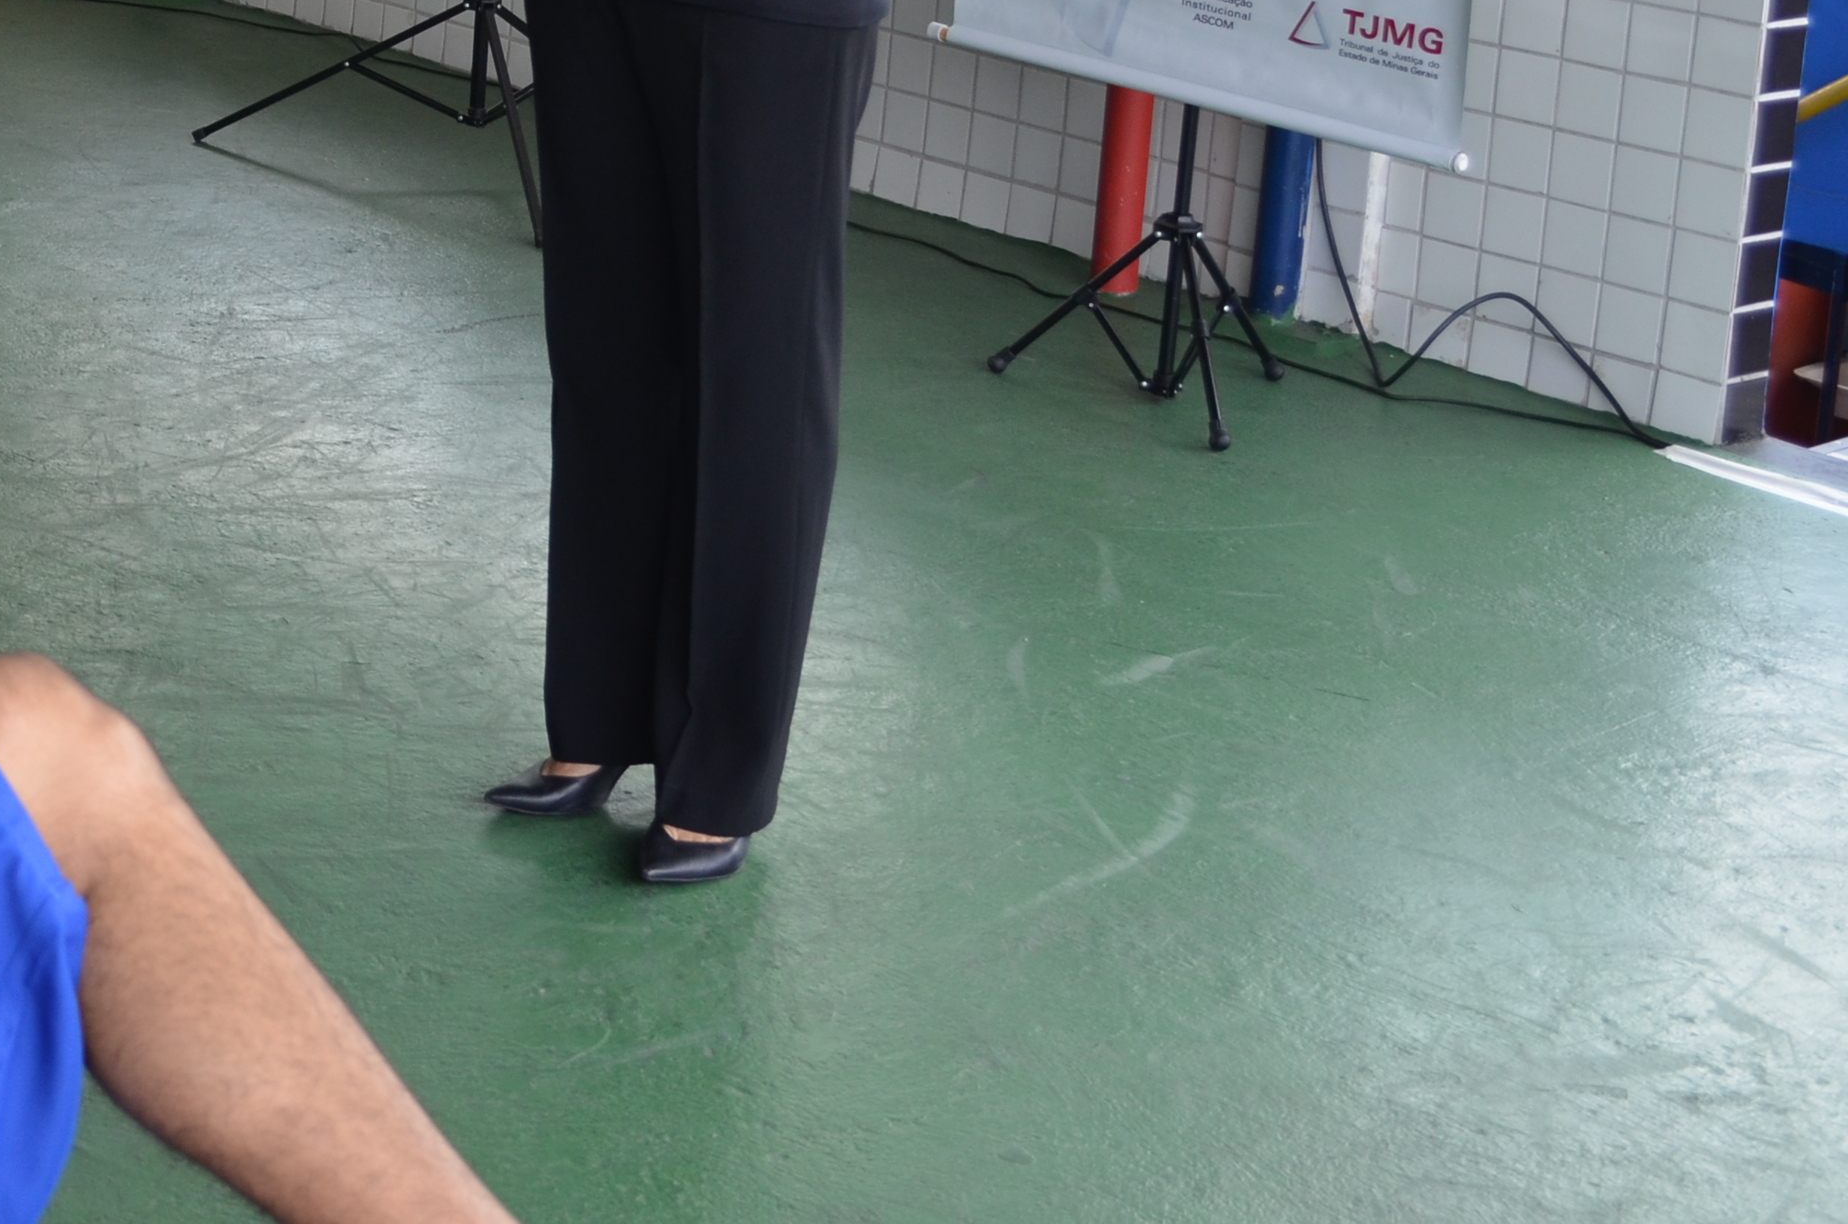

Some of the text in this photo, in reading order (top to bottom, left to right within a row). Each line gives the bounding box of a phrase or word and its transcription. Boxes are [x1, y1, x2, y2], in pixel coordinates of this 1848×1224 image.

[1193, 13, 1234, 30] ASCOM
[1342, 8, 1444, 55] TJMG
[1338, 48, 1439, 80] Estado de Minas Gerais
[1339, 38, 1440, 69] Tribunal de Justiça do
